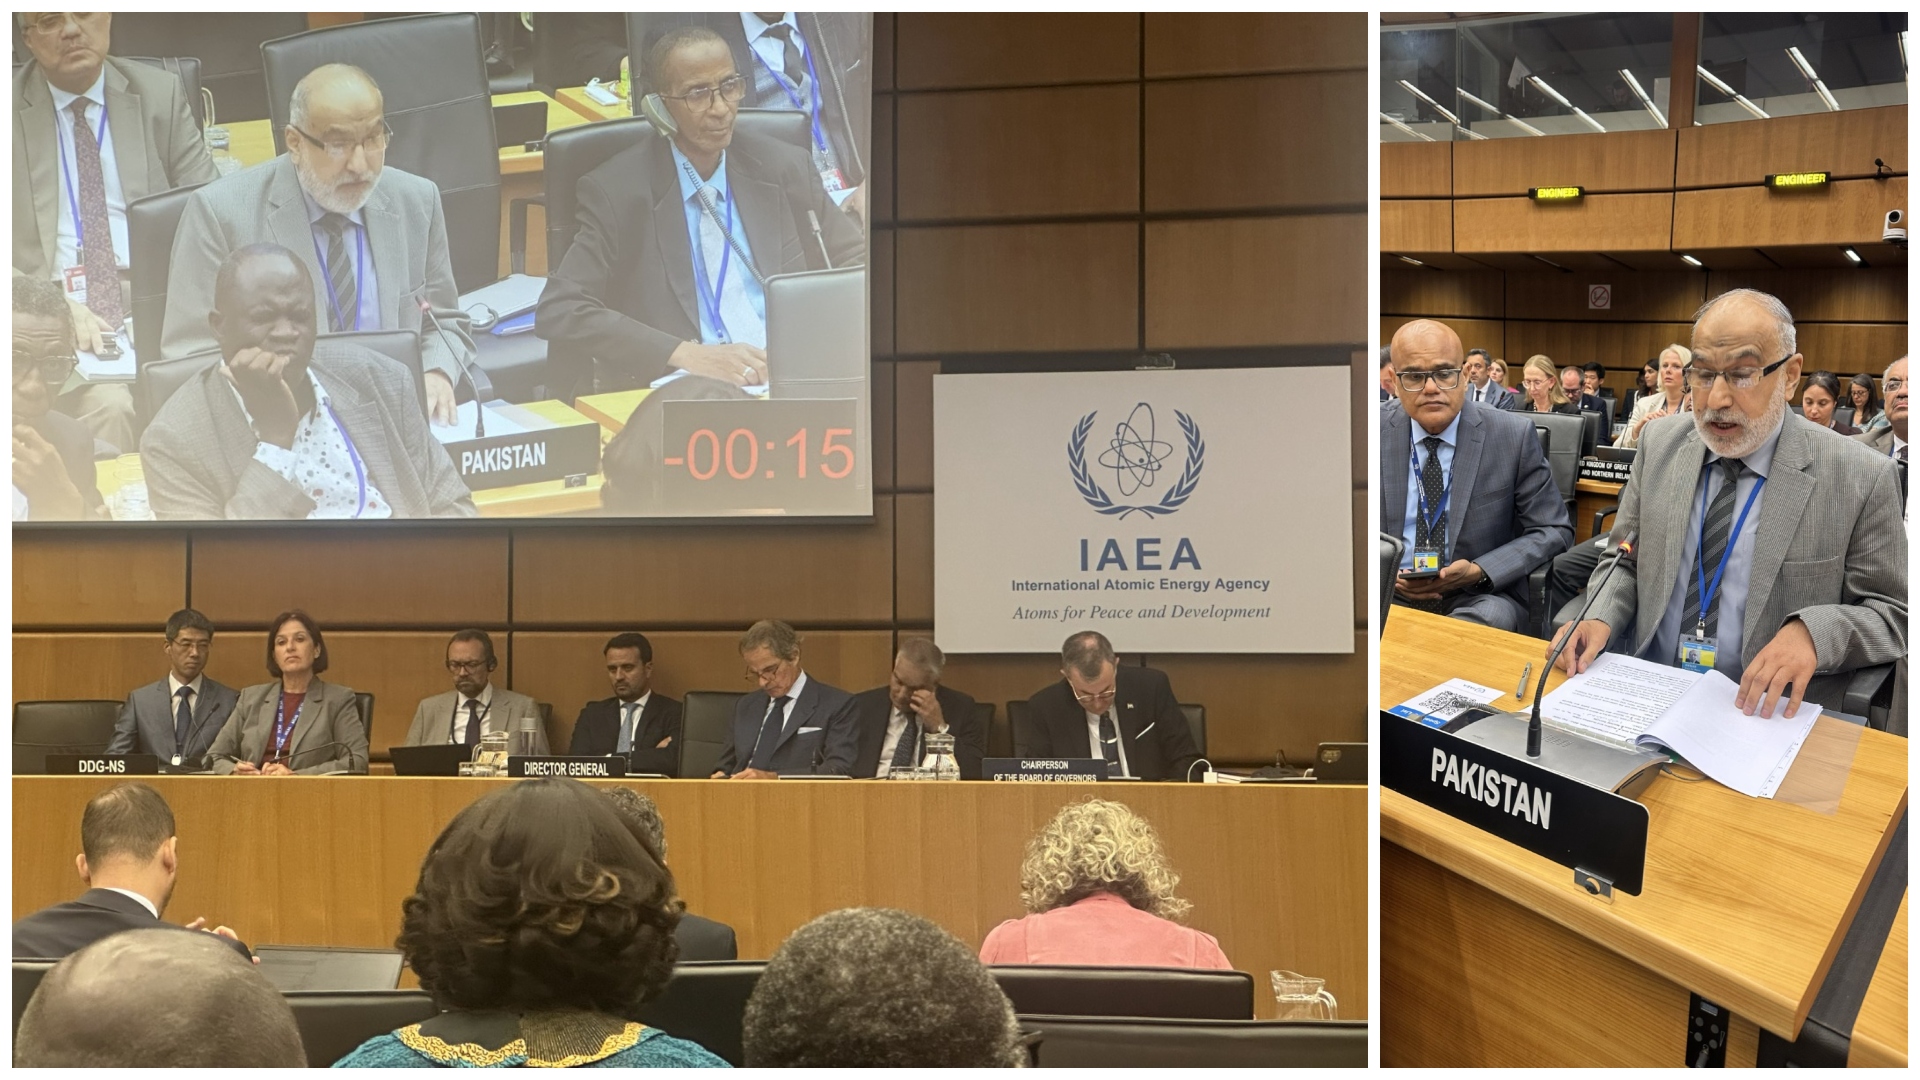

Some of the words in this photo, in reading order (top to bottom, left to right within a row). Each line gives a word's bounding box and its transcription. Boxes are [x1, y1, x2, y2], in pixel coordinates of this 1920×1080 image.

[1775, 173, 1826, 186] ENGINEER
[1537, 187, 1579, 198] ENGINEER
[462, 442, 546, 475] PAKISTAN
[664, 428, 855, 481] -00:15
[1586, 461, 1606, 469] KINGDOM
[1614, 463, 1628, 471] GREAT
[1591, 470, 1614, 478] NORTHERN
[1615, 472, 1630, 480] IRELAN
[1080, 537, 1202, 571] IAEA
[1011, 579, 1100, 591] International
[1104, 578, 1155, 590] Atomic
[1159, 578, 1210, 592] Energy
[1215, 577, 1270, 592] Agency
[1012, 606, 1059, 620] Atoms
[1060, 605, 1085, 622] for
[1090, 605, 1133, 619] Peace
[1137, 604, 1167, 618] and
[1171, 604, 1271, 621] Development
[78, 759, 126, 773] DDG-NS
[524, 761, 567, 775] DIRECTOR
[568, 762, 609, 776] GENERAL
[1021, 760, 1068, 770] CHAIRPERSON
[993, 773, 1003, 781] OF
[1004, 773, 1017, 782] THE
[1019, 773, 1043, 782] BOARD
[1043, 773, 1053, 782] OF
[1054, 774, 1097, 782] GOVERNORS
[1431, 747, 1552, 830] PAKISTAN
